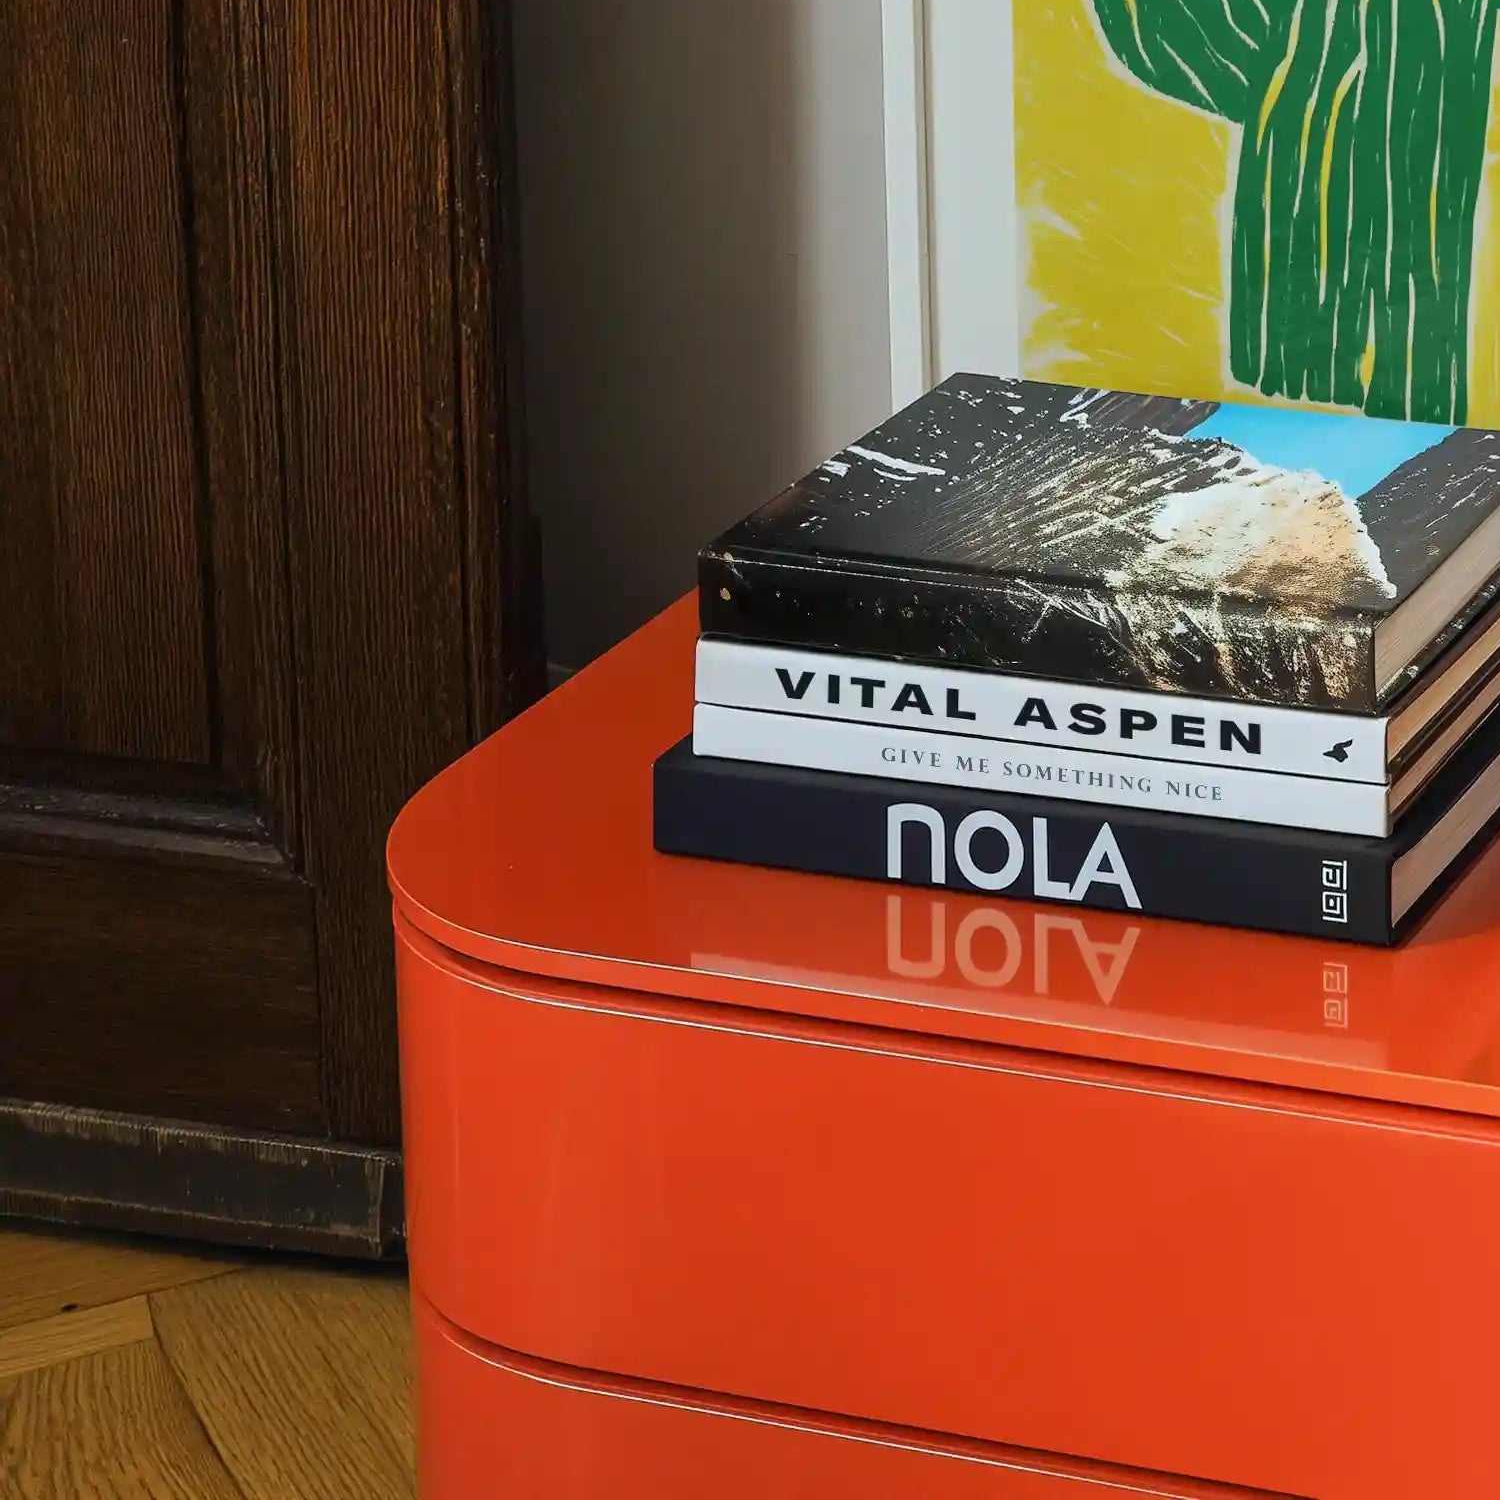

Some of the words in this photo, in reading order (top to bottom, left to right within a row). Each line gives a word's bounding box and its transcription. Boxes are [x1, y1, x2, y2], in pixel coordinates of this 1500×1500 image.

[774, 667, 977, 721] VITAL
[1013, 697, 1262, 755] ASPEN
[880, 746, 942, 768] GIVE
[955, 755, 990, 774] ME
[1002, 761, 1152, 793] SOMETHING
[1164, 779, 1223, 802] NICE
